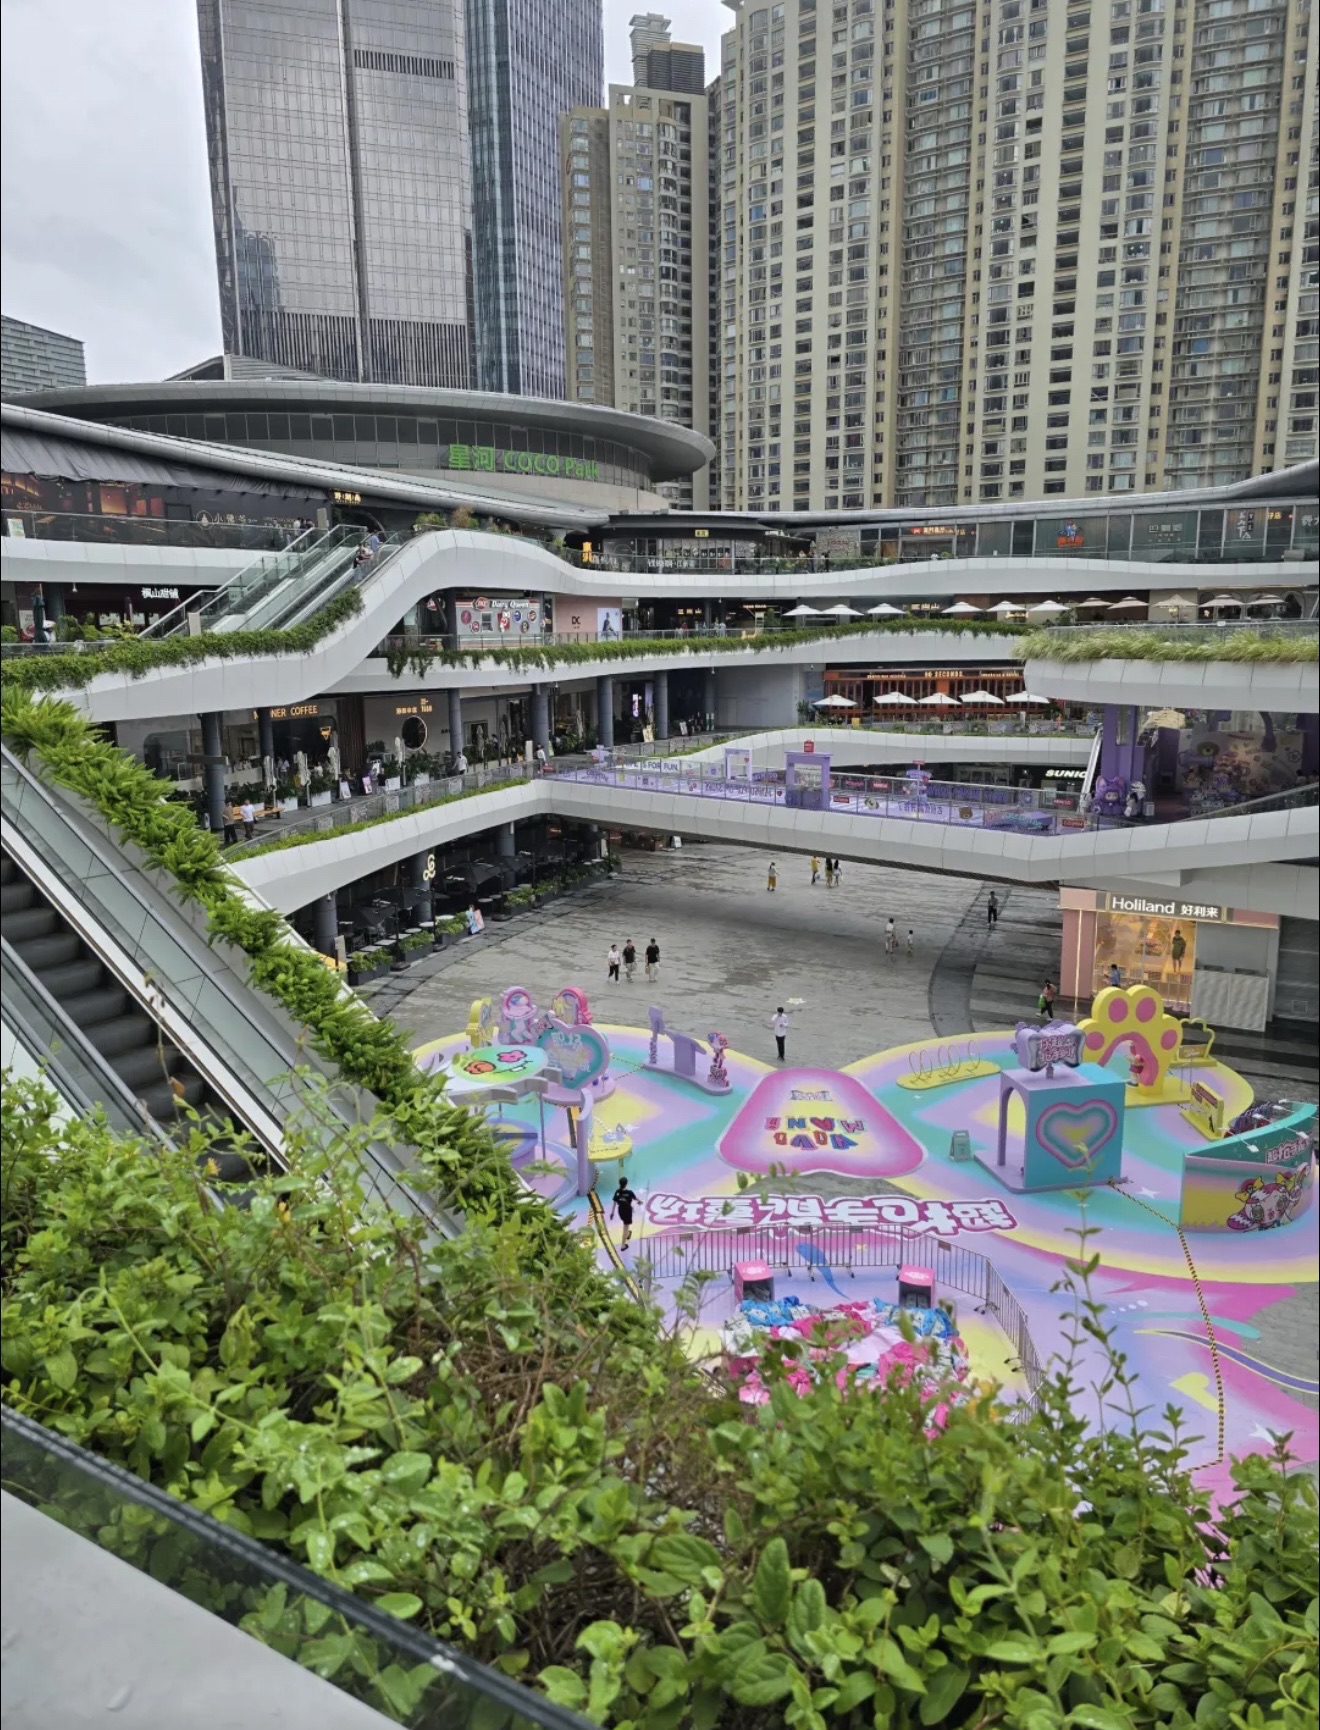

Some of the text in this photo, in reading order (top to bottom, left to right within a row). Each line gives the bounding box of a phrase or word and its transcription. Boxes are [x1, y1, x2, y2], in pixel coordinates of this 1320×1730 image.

[449, 443, 496, 471] 星河
[504, 451, 600, 480] COCO Park
[290, 705, 318, 716] COFFEE
[1112, 896, 1176, 914] Holiland
[1180, 904, 1219, 918] 好利来
